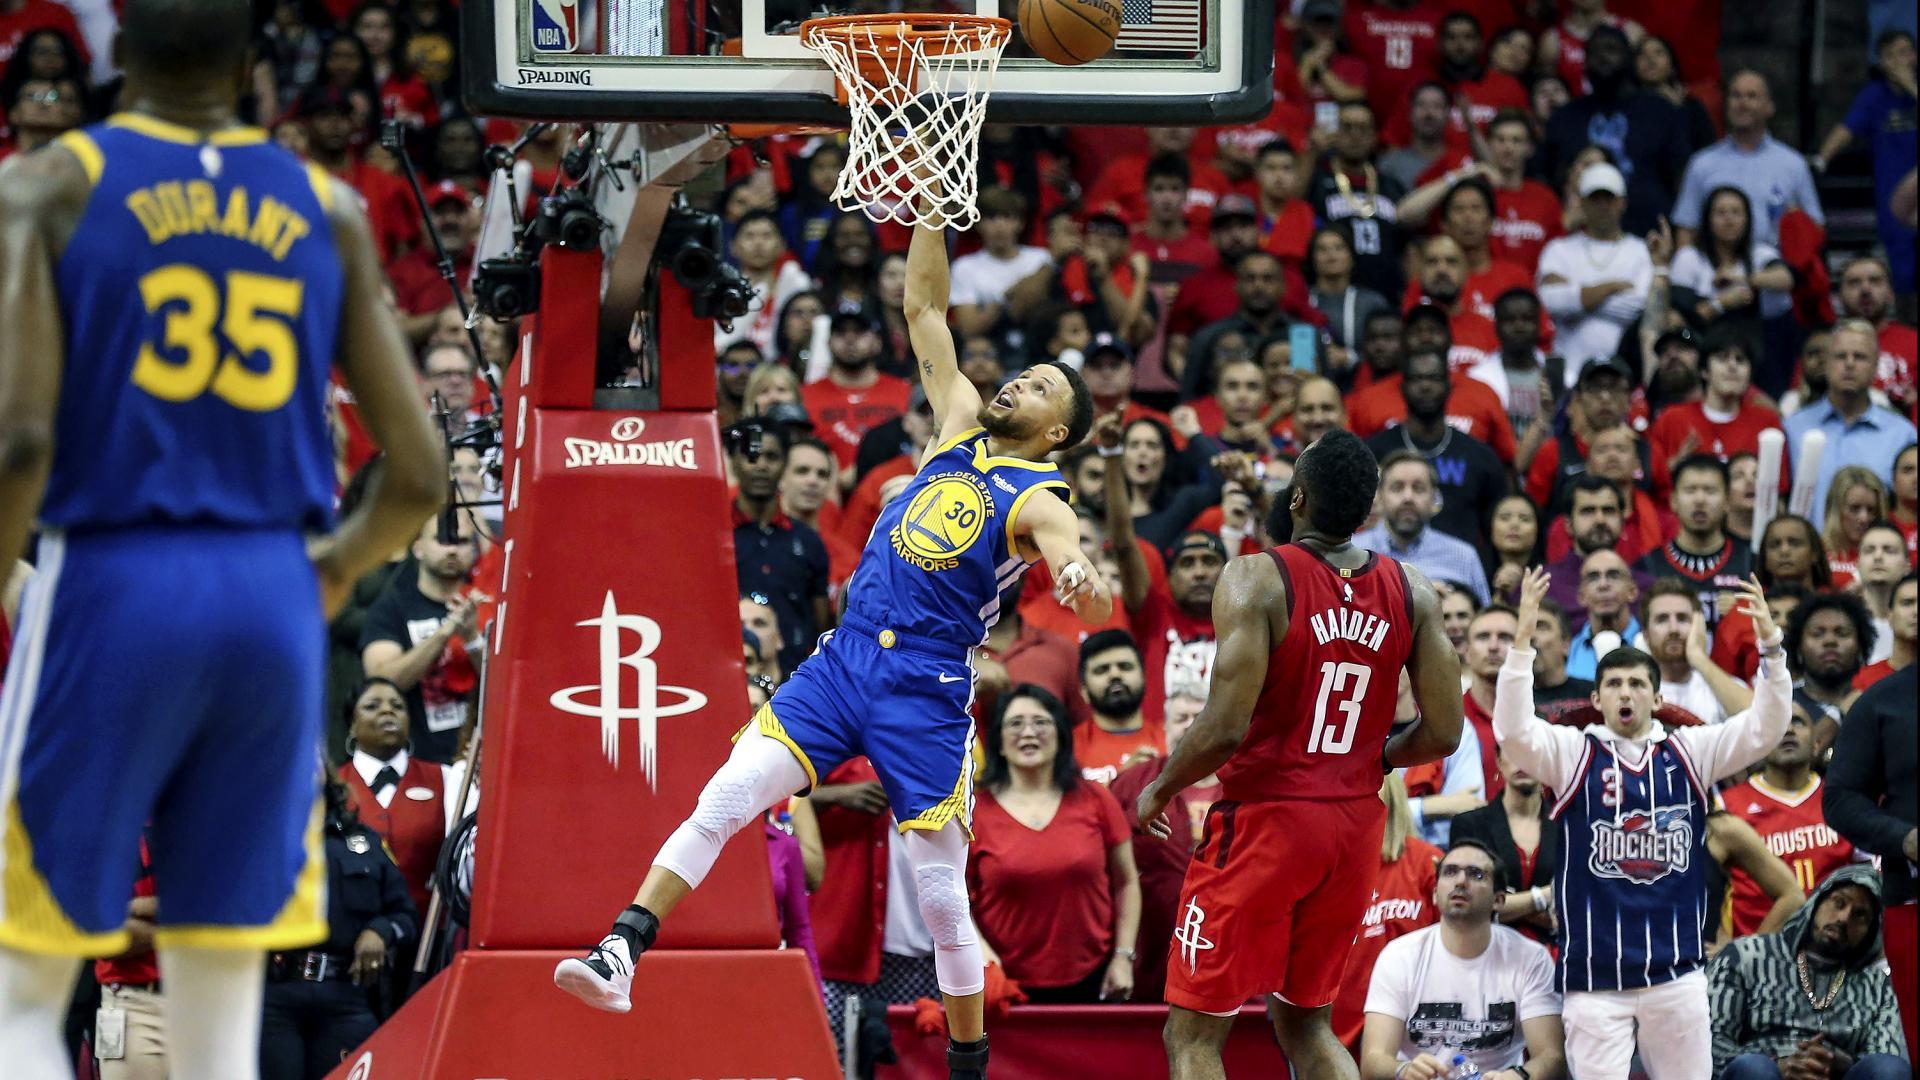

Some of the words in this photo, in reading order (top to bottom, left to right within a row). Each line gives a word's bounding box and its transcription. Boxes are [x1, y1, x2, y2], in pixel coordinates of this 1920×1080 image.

[537, 28, 560, 46] NBA
[518, 68, 592, 86] SPALDING
[126, 180, 309, 261] DURANT
[131, 263, 303, 412] 35
[563, 437, 698, 470] SPALDING
[991, 473, 1018, 495] Rakuten
[1435, 457, 1467, 487] W
[927, 471, 979, 483] GOLDEN
[977, 478, 996, 518] STATE
[945, 501, 977, 529] 30
[889, 524, 959, 572] WARRIORS
[1310, 607, 1390, 652] HARDEN
[1307, 661, 1372, 755] 13
[1599, 825, 1686, 867] ROCKETS
[1761, 823, 1839, 857] HOUSTON
[1793, 859, 1815, 890] 11
